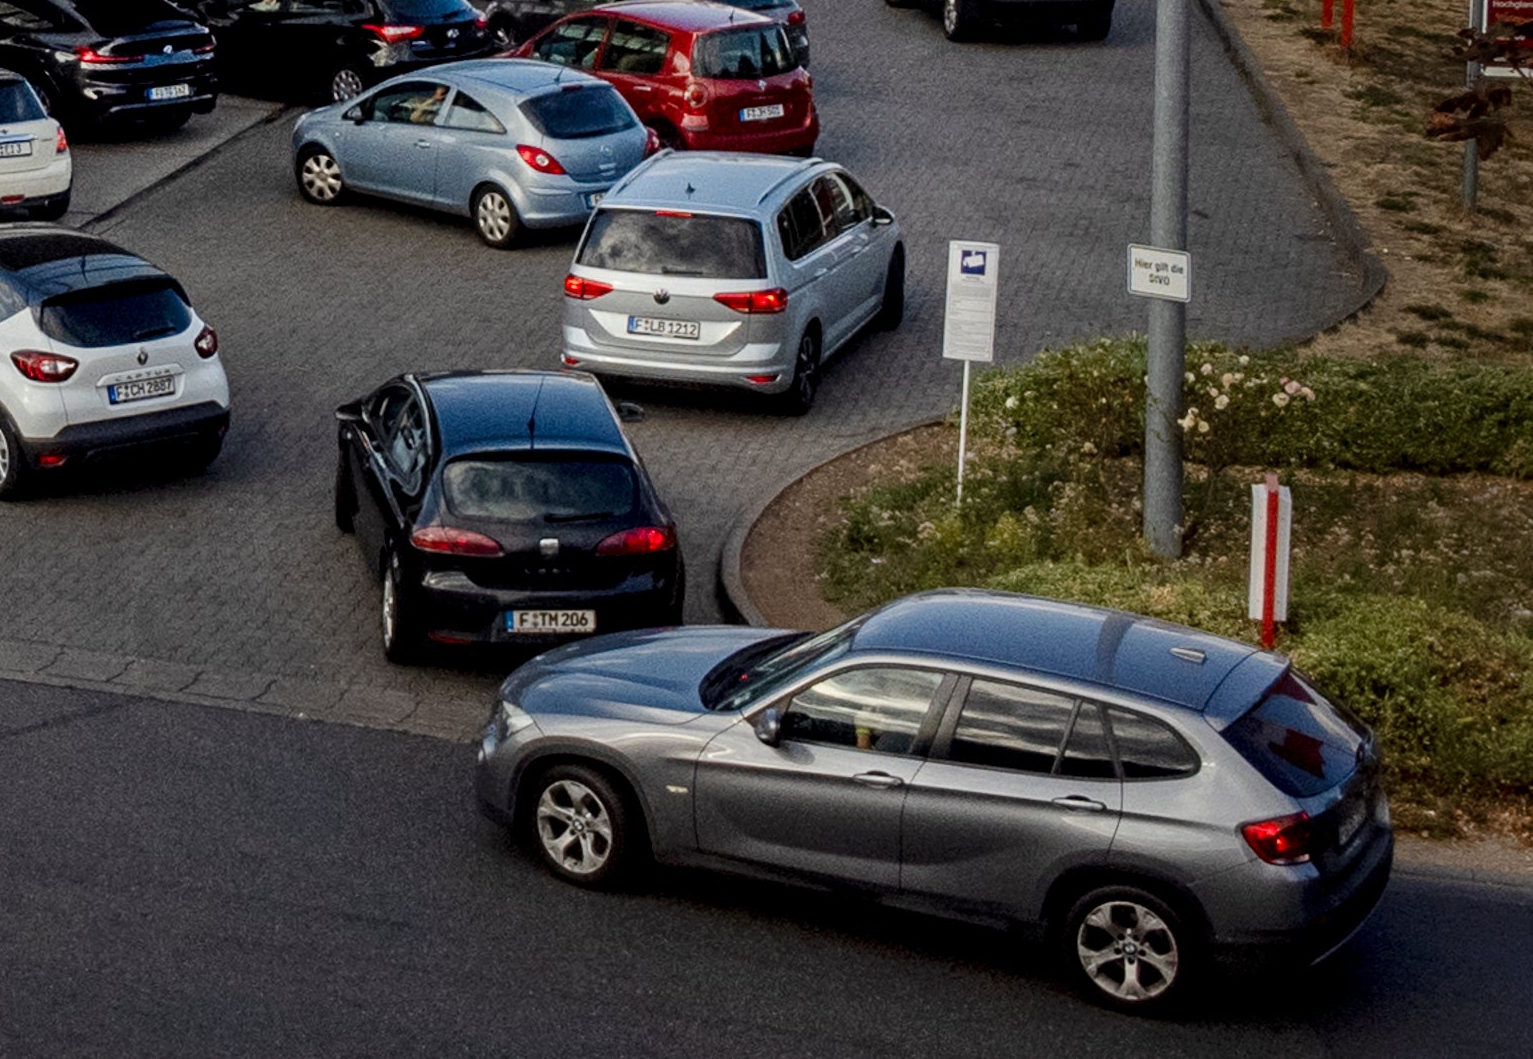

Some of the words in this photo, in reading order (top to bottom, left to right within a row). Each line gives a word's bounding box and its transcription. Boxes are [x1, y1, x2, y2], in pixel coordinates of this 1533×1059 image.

[1134, 258, 1153, 270] Hier
[1155, 261, 1169, 273] gilt
[1170, 264, 1184, 275] die
[560, 612, 589, 627] 206
